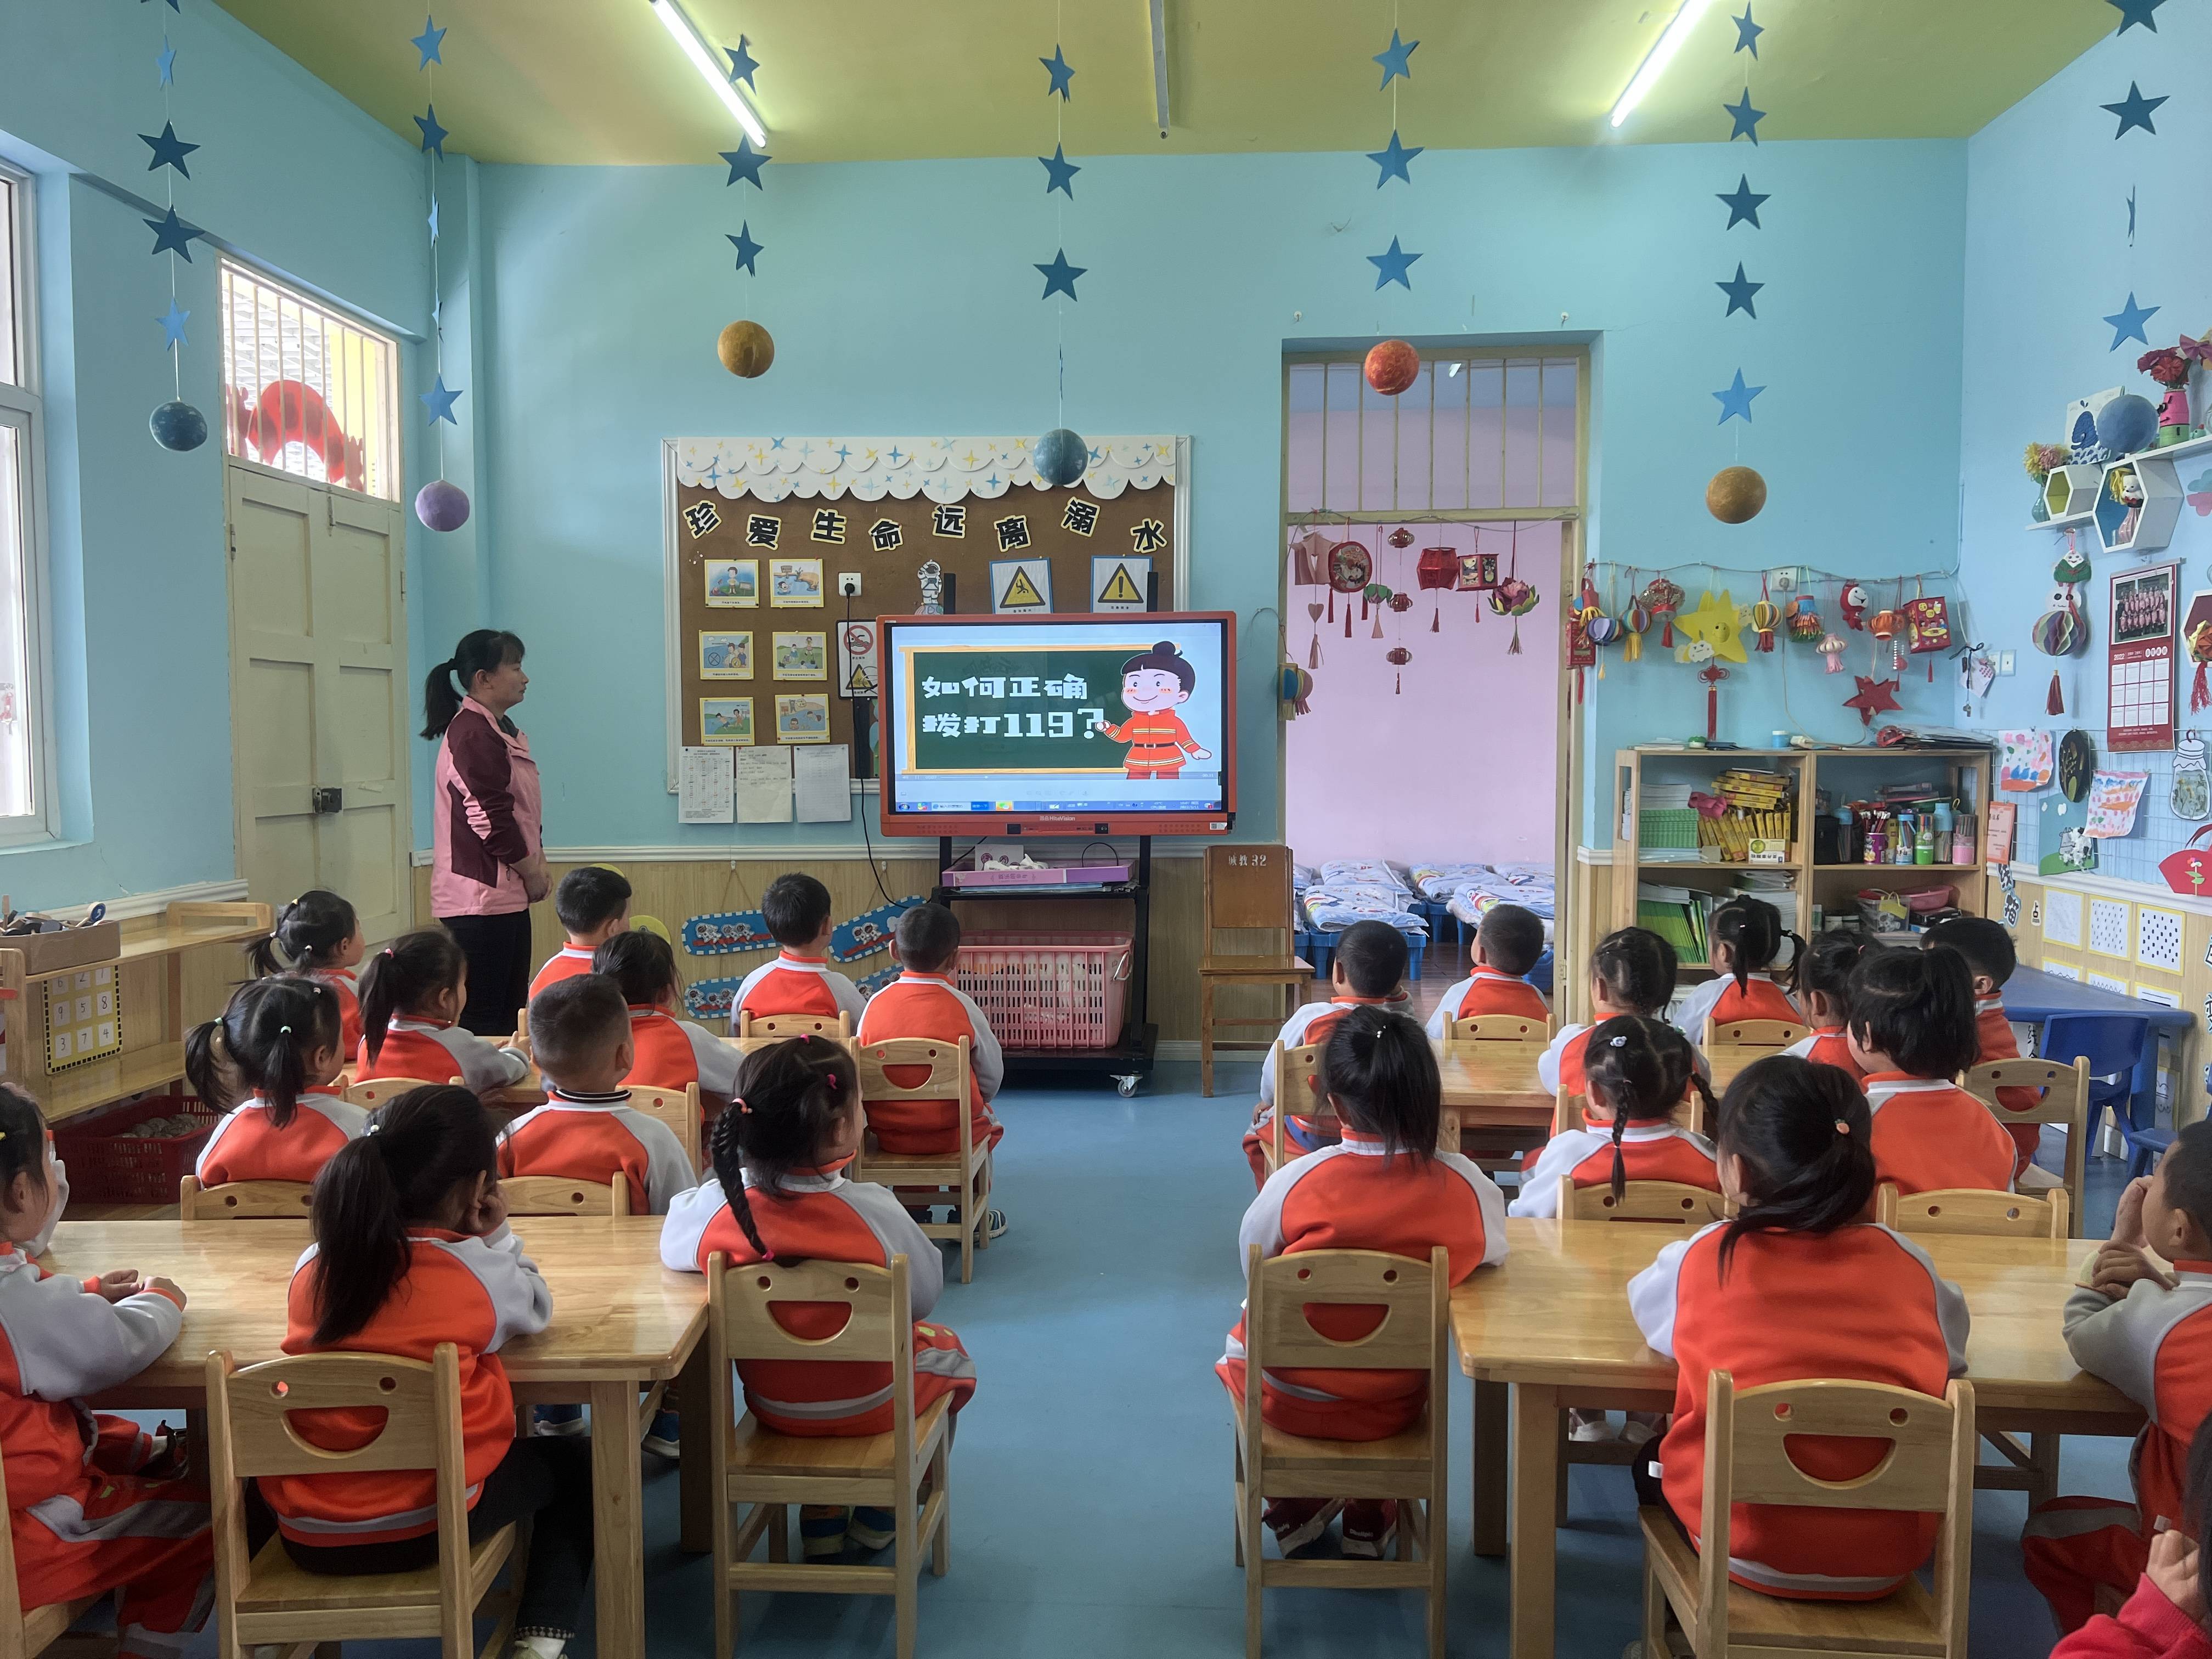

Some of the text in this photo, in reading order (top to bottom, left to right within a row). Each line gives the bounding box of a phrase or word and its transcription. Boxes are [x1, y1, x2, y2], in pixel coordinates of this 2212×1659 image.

[922, 673, 1088, 699] 如何正确
[58, 996, 108, 1020] 9 5 8
[61, 1028, 109, 1051] 3 7 4
